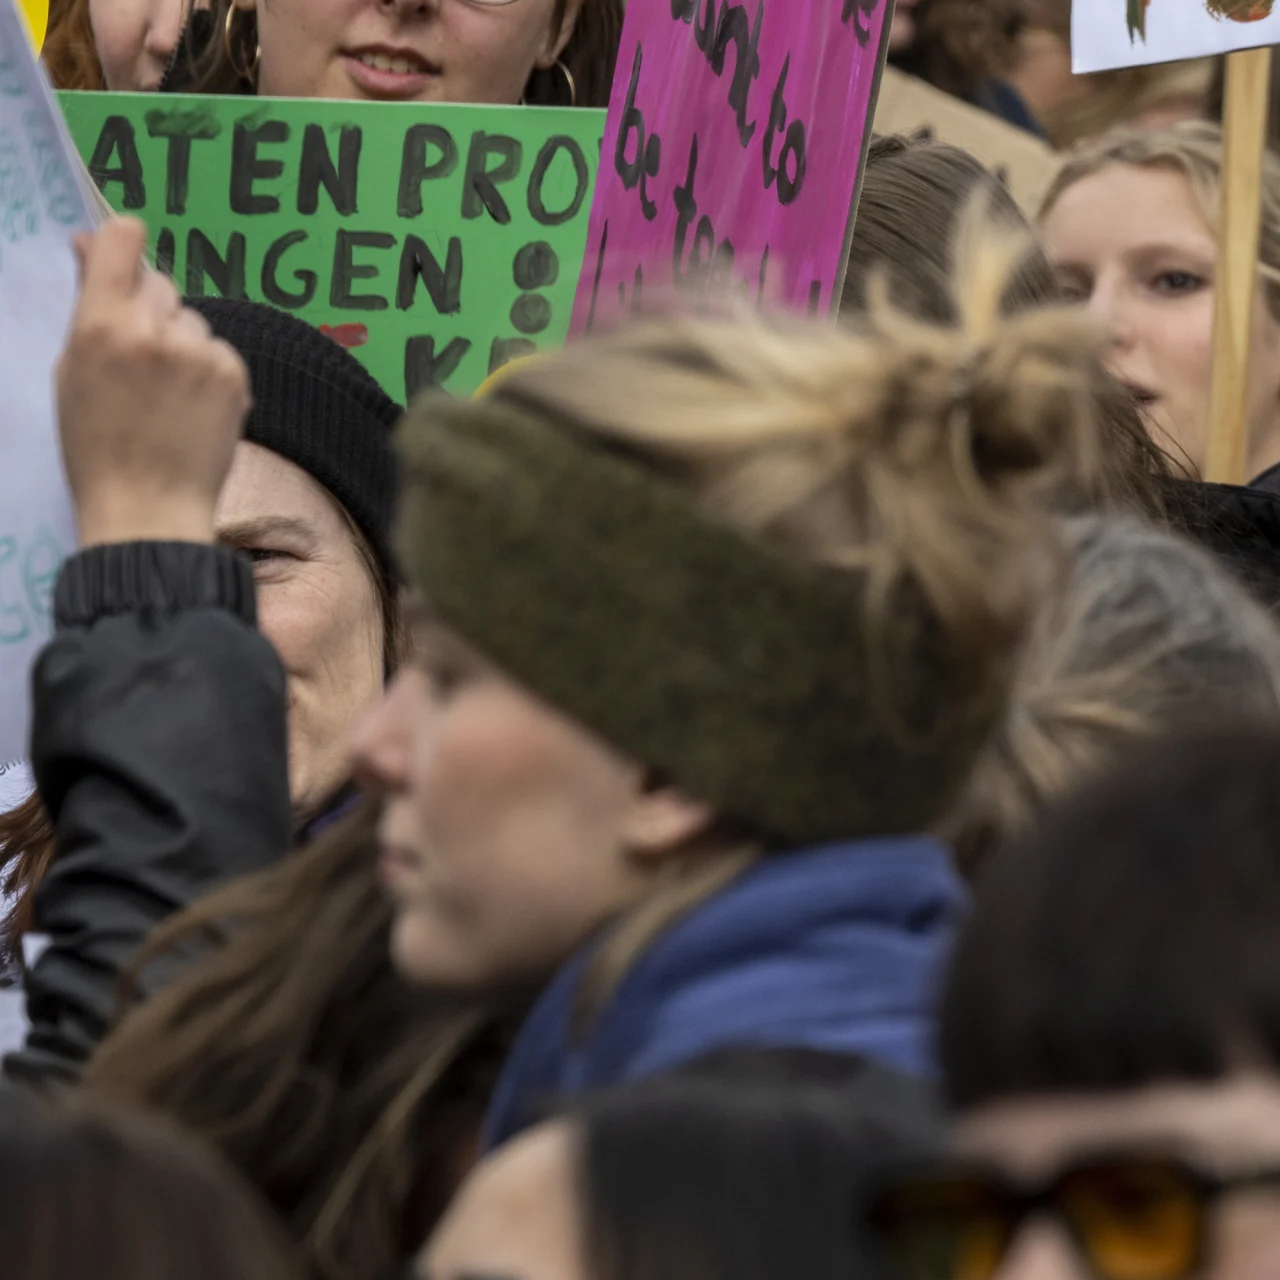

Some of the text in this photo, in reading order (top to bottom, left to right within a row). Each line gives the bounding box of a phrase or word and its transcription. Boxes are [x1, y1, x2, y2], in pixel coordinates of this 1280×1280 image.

[396, 123, 603, 227] PRO
[614, 40, 806, 222] be to
